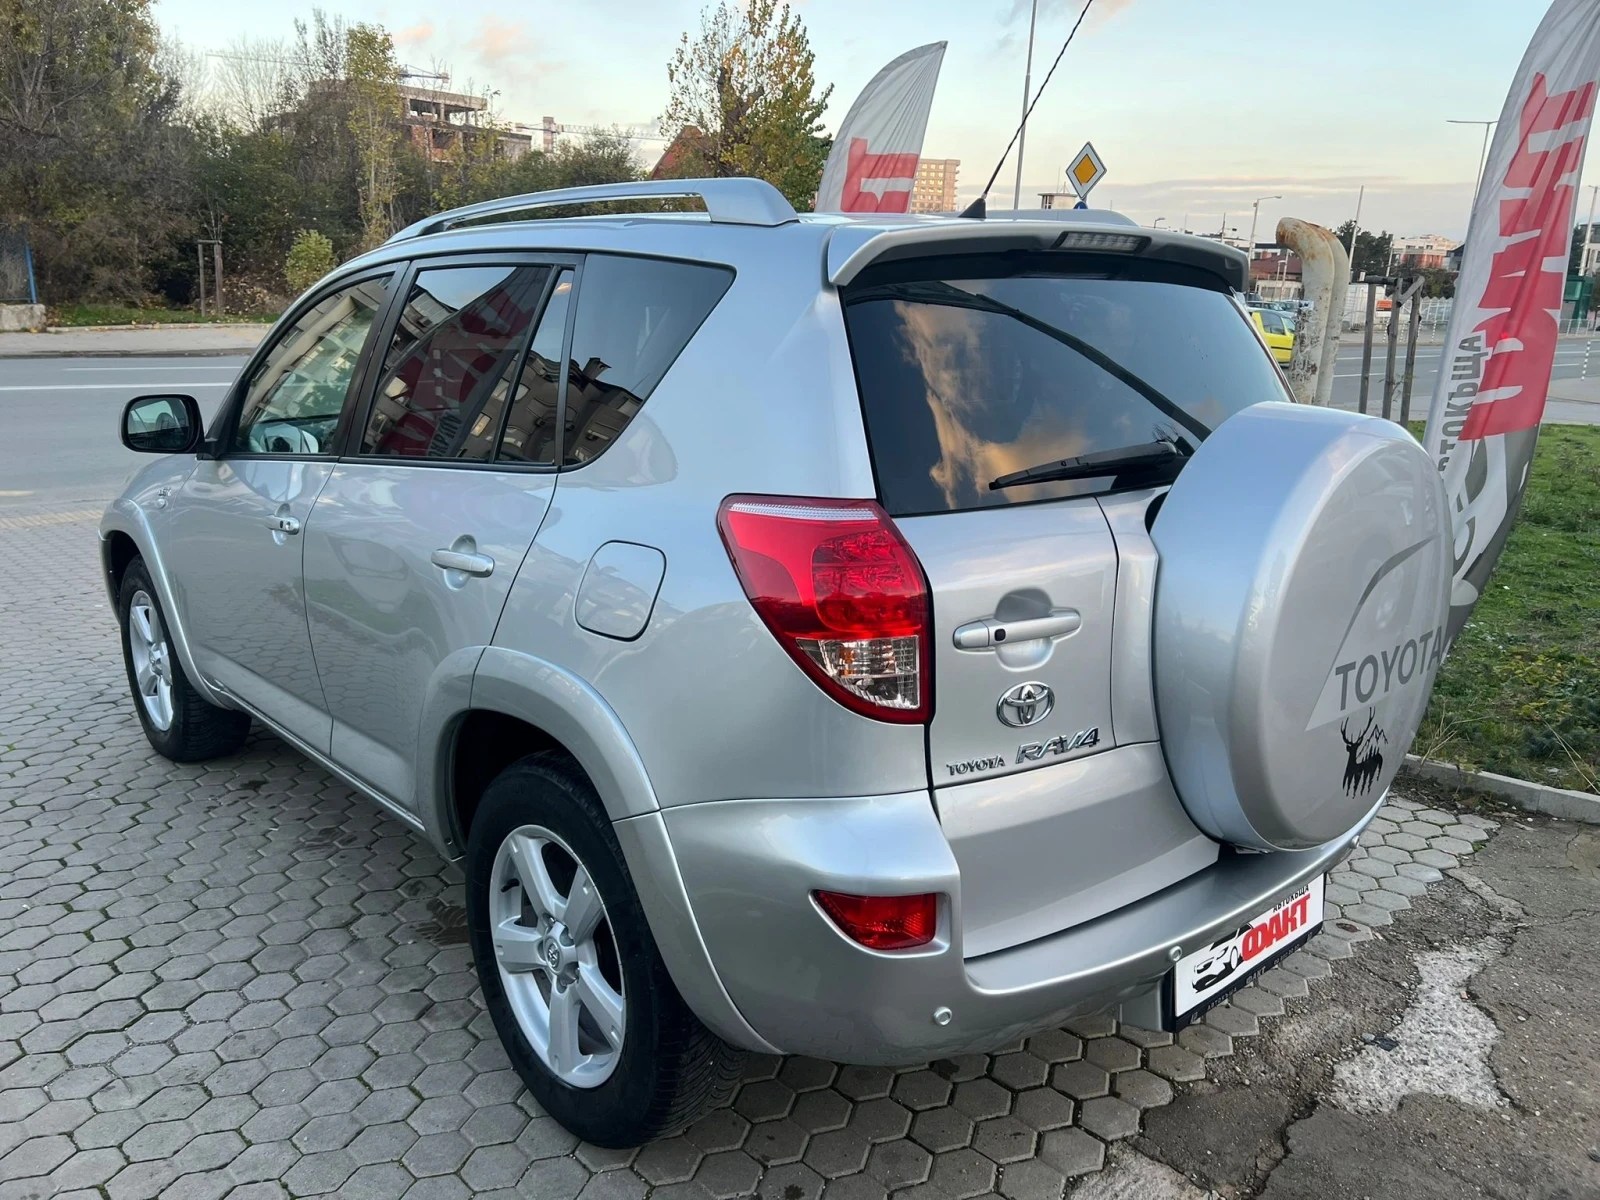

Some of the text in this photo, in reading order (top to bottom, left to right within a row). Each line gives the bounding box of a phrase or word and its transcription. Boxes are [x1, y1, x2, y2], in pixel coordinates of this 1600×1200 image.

[1437, 335, 1488, 472] ТОКЪЩА
[1335, 625, 1442, 711] TOYOTA
[946, 727, 1101, 776] TOYOTA RAV4
[1241, 893, 1311, 962] ФАКТ
